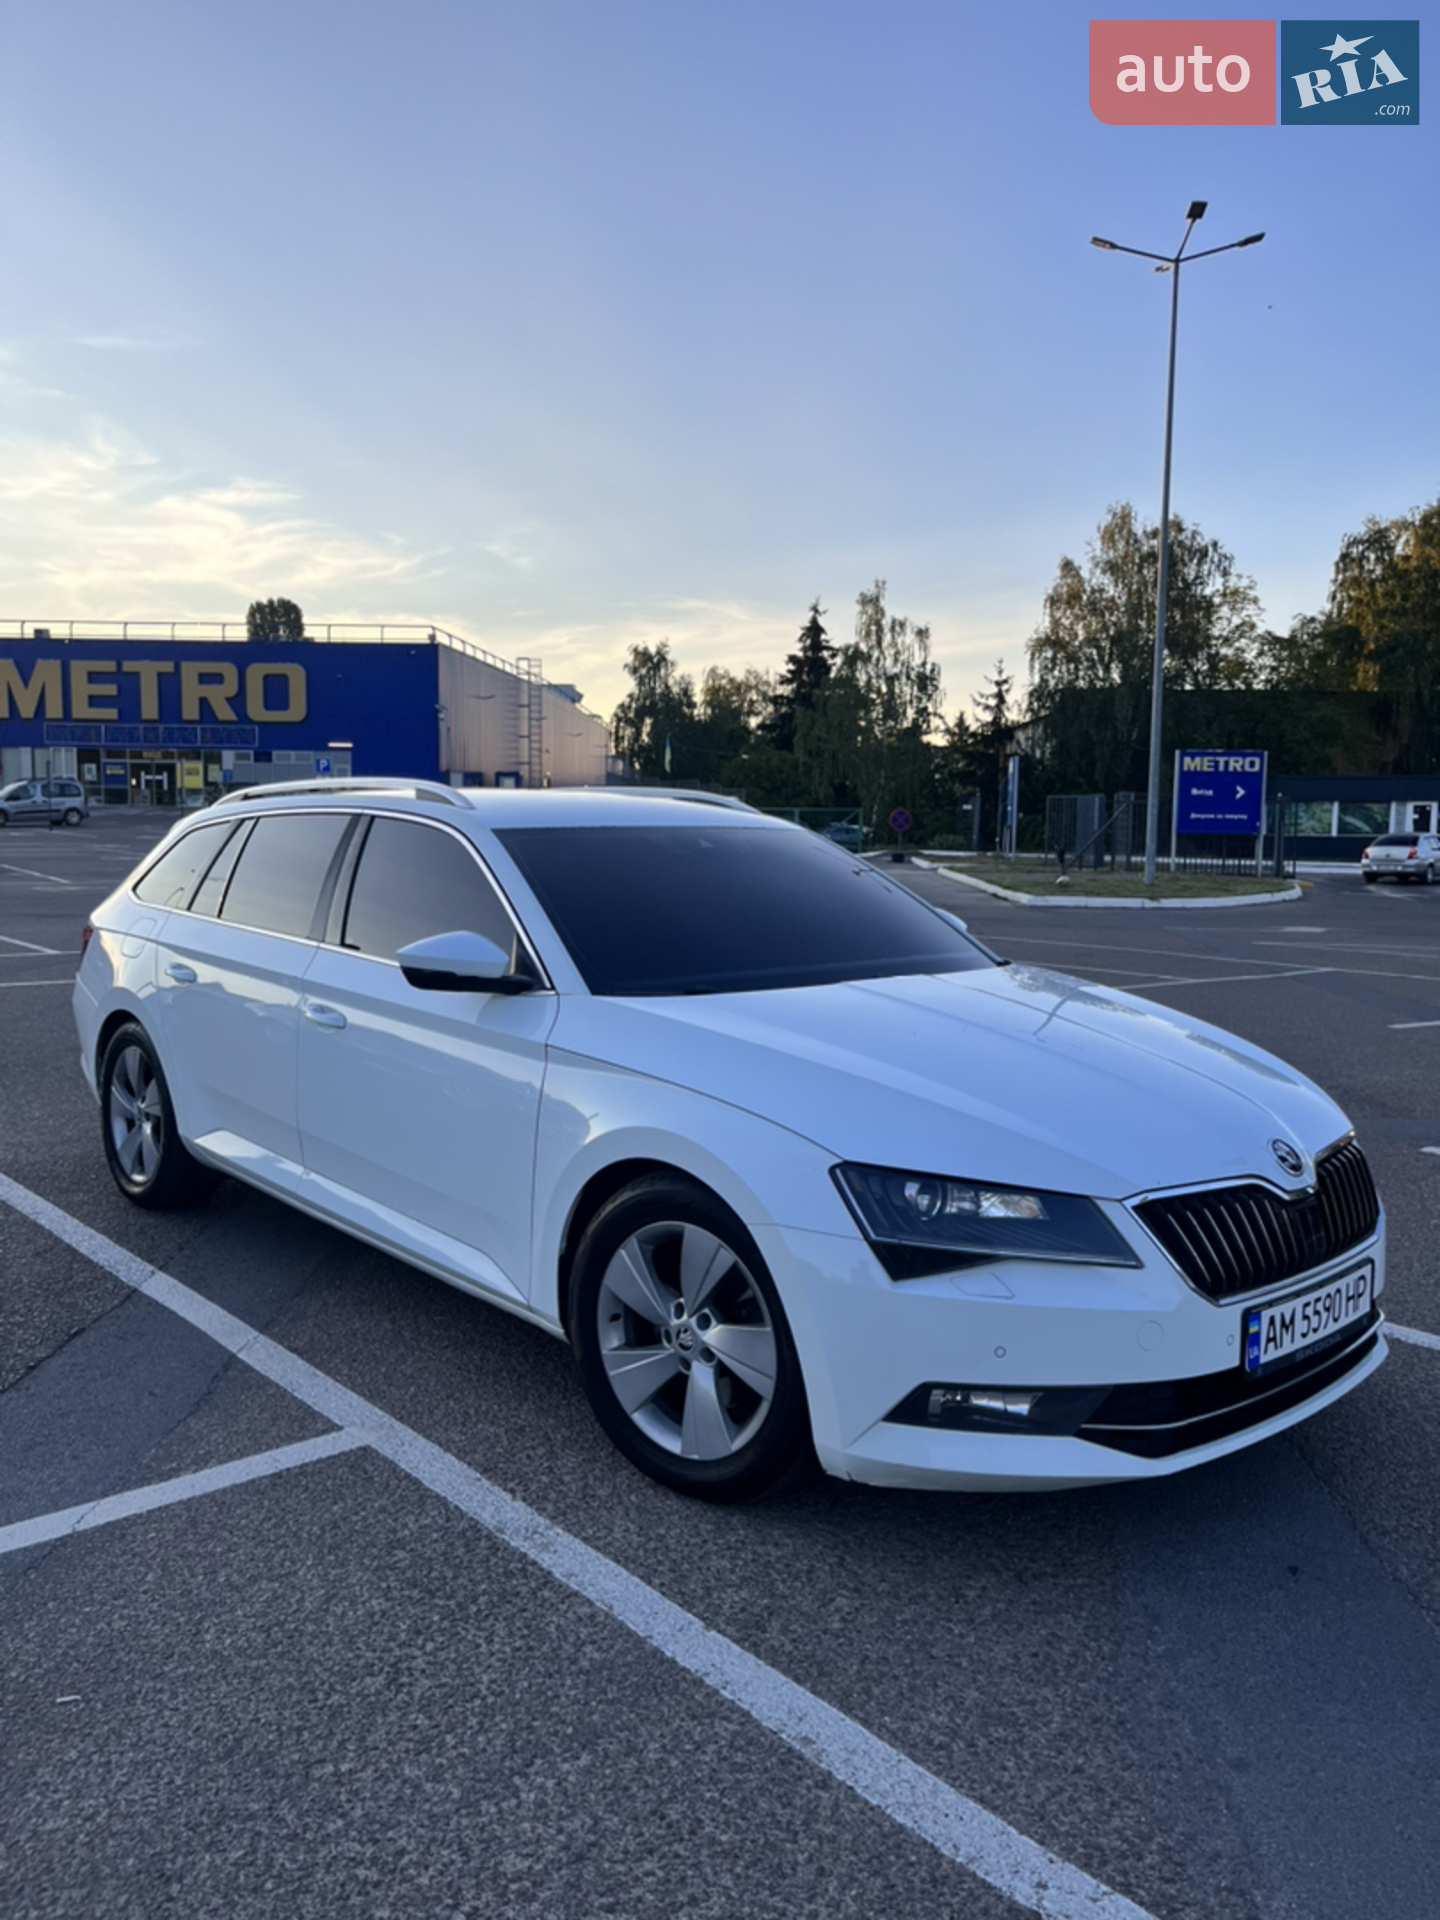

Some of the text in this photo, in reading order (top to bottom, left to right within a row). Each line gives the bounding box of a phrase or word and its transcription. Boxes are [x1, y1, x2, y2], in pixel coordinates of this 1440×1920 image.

[0, 658, 308, 722] METRO
[1183, 756, 1260, 772] METRO
[1263, 1274, 1367, 1355] AM 5590 HP
